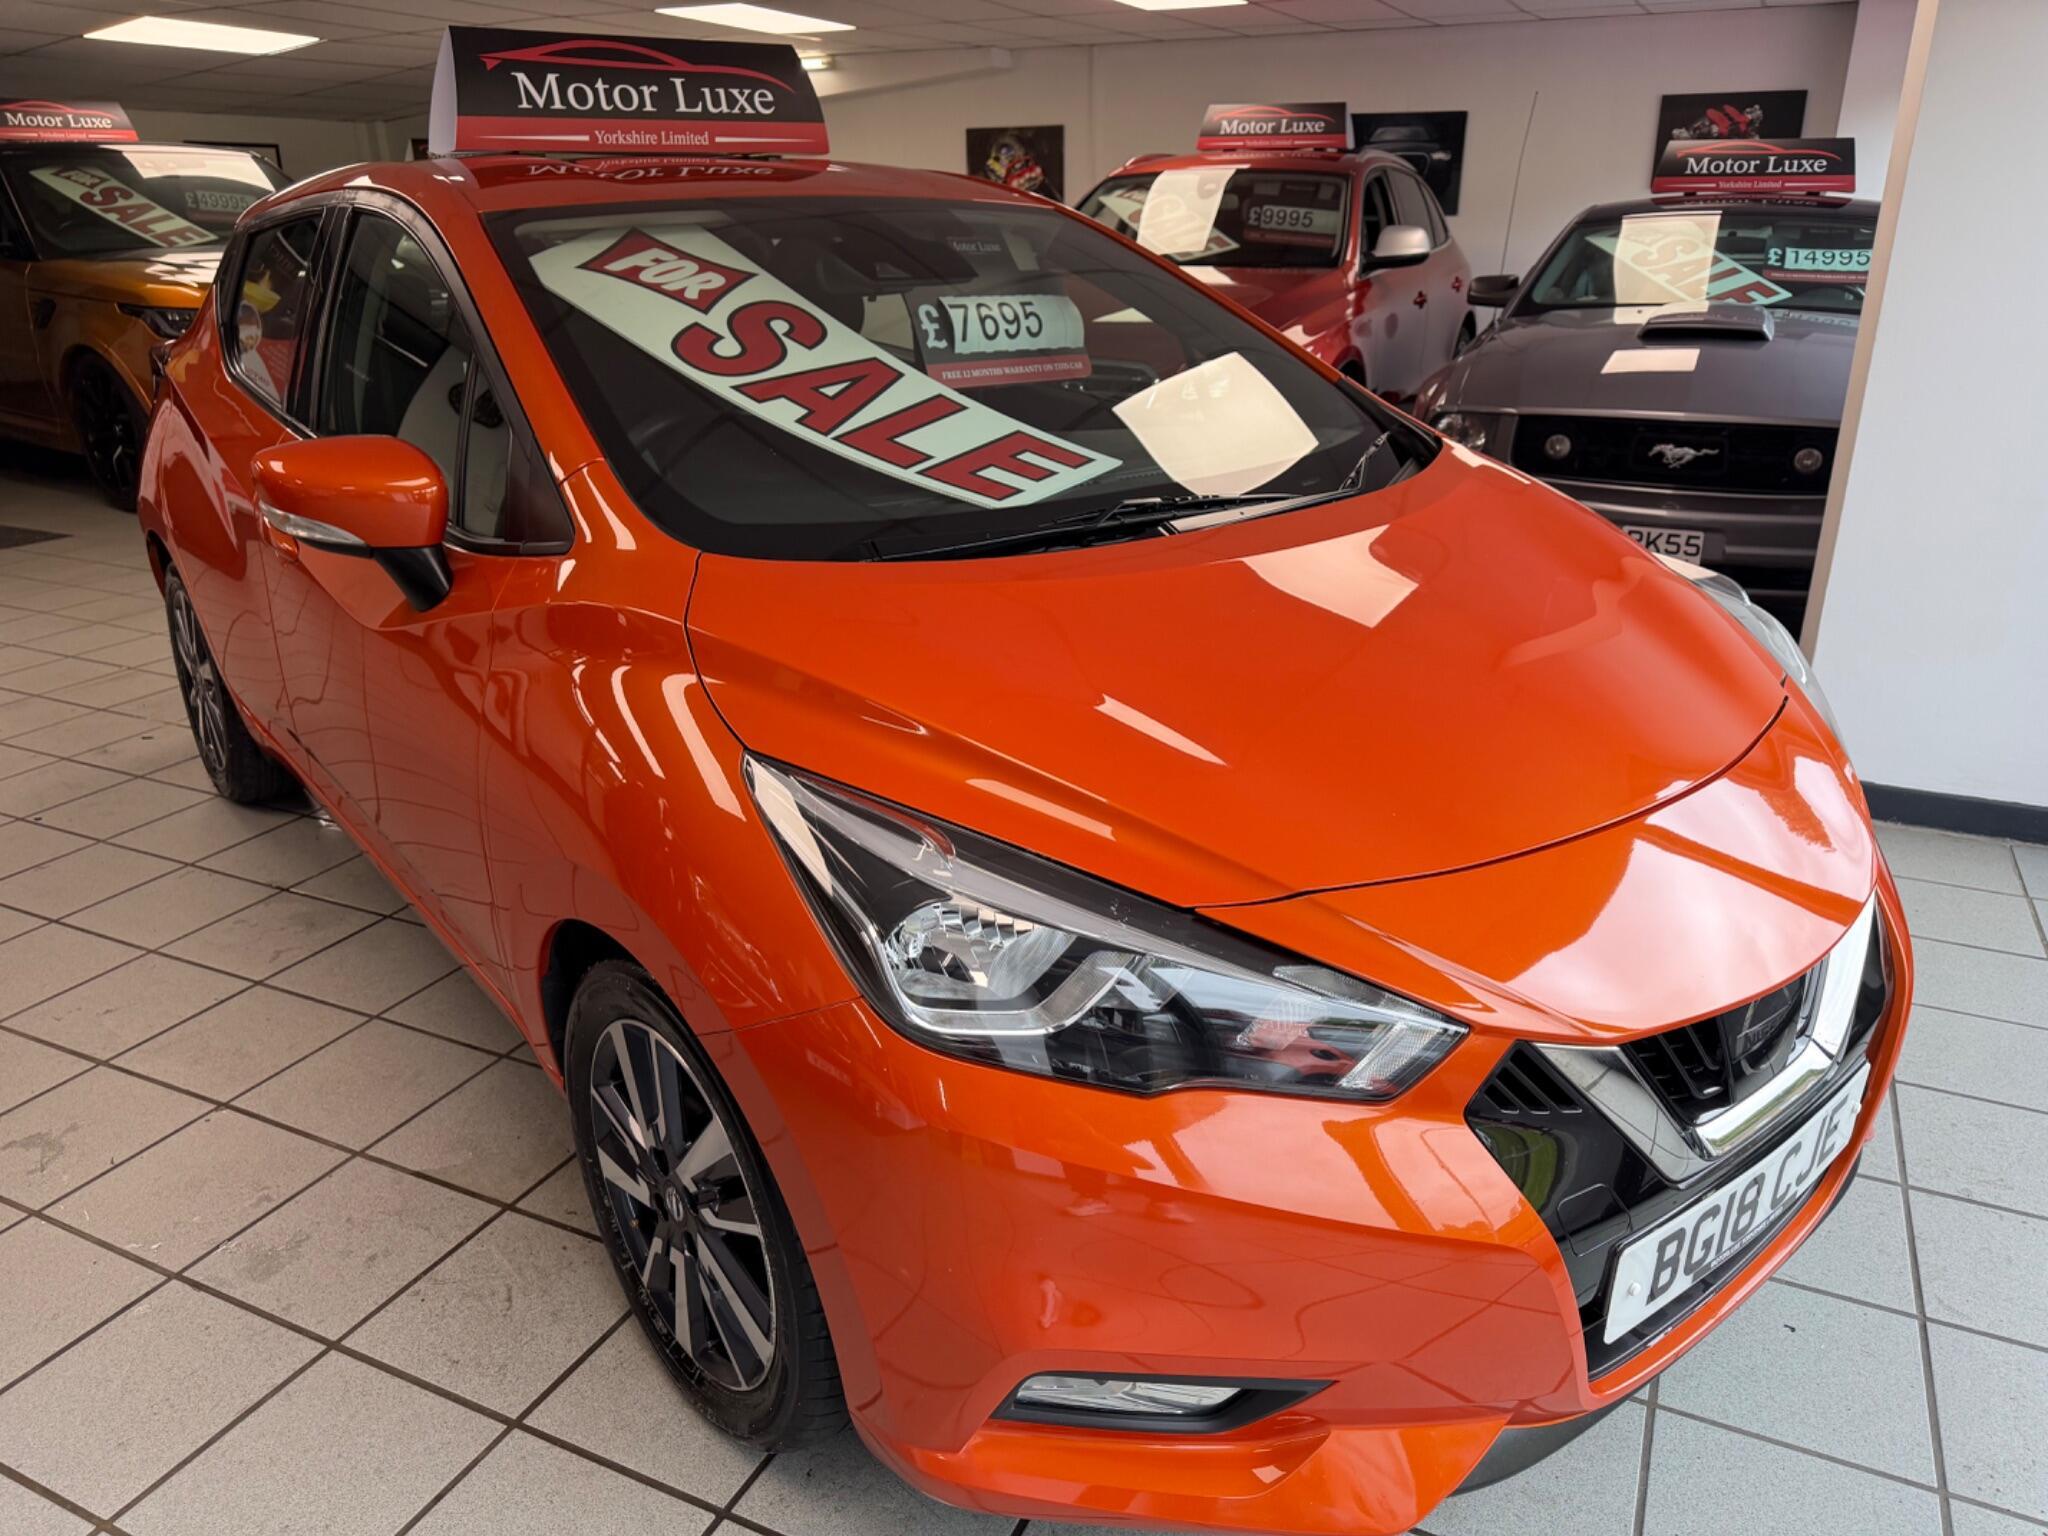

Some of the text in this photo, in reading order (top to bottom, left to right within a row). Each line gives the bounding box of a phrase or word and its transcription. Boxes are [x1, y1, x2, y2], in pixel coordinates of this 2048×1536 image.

[510, 71, 776, 115] Motor Luxe
[4, 111, 113, 129] Motor Luxe
[1220, 118, 1325, 135] Motor Luxe
[594, 130, 709, 146] Yorkshire Limited
[1685, 156, 1828, 174] Motor Luxe
[79, 185, 211, 248] SALE
[1767, 247, 1871, 266] £14995
[604, 247, 727, 301] FOR
[918, 301, 1043, 349] £7695
[942, 370, 962, 380] FREE
[970, 368, 1003, 378] MONTHS
[1004, 365, 1042, 376] WARRANTY
[1044, 363, 1053, 373] ON
[670, 299, 1097, 502] SALE
[1646, 1172, 1766, 1305] BG18
[1770, 1094, 1849, 1211] CJE
